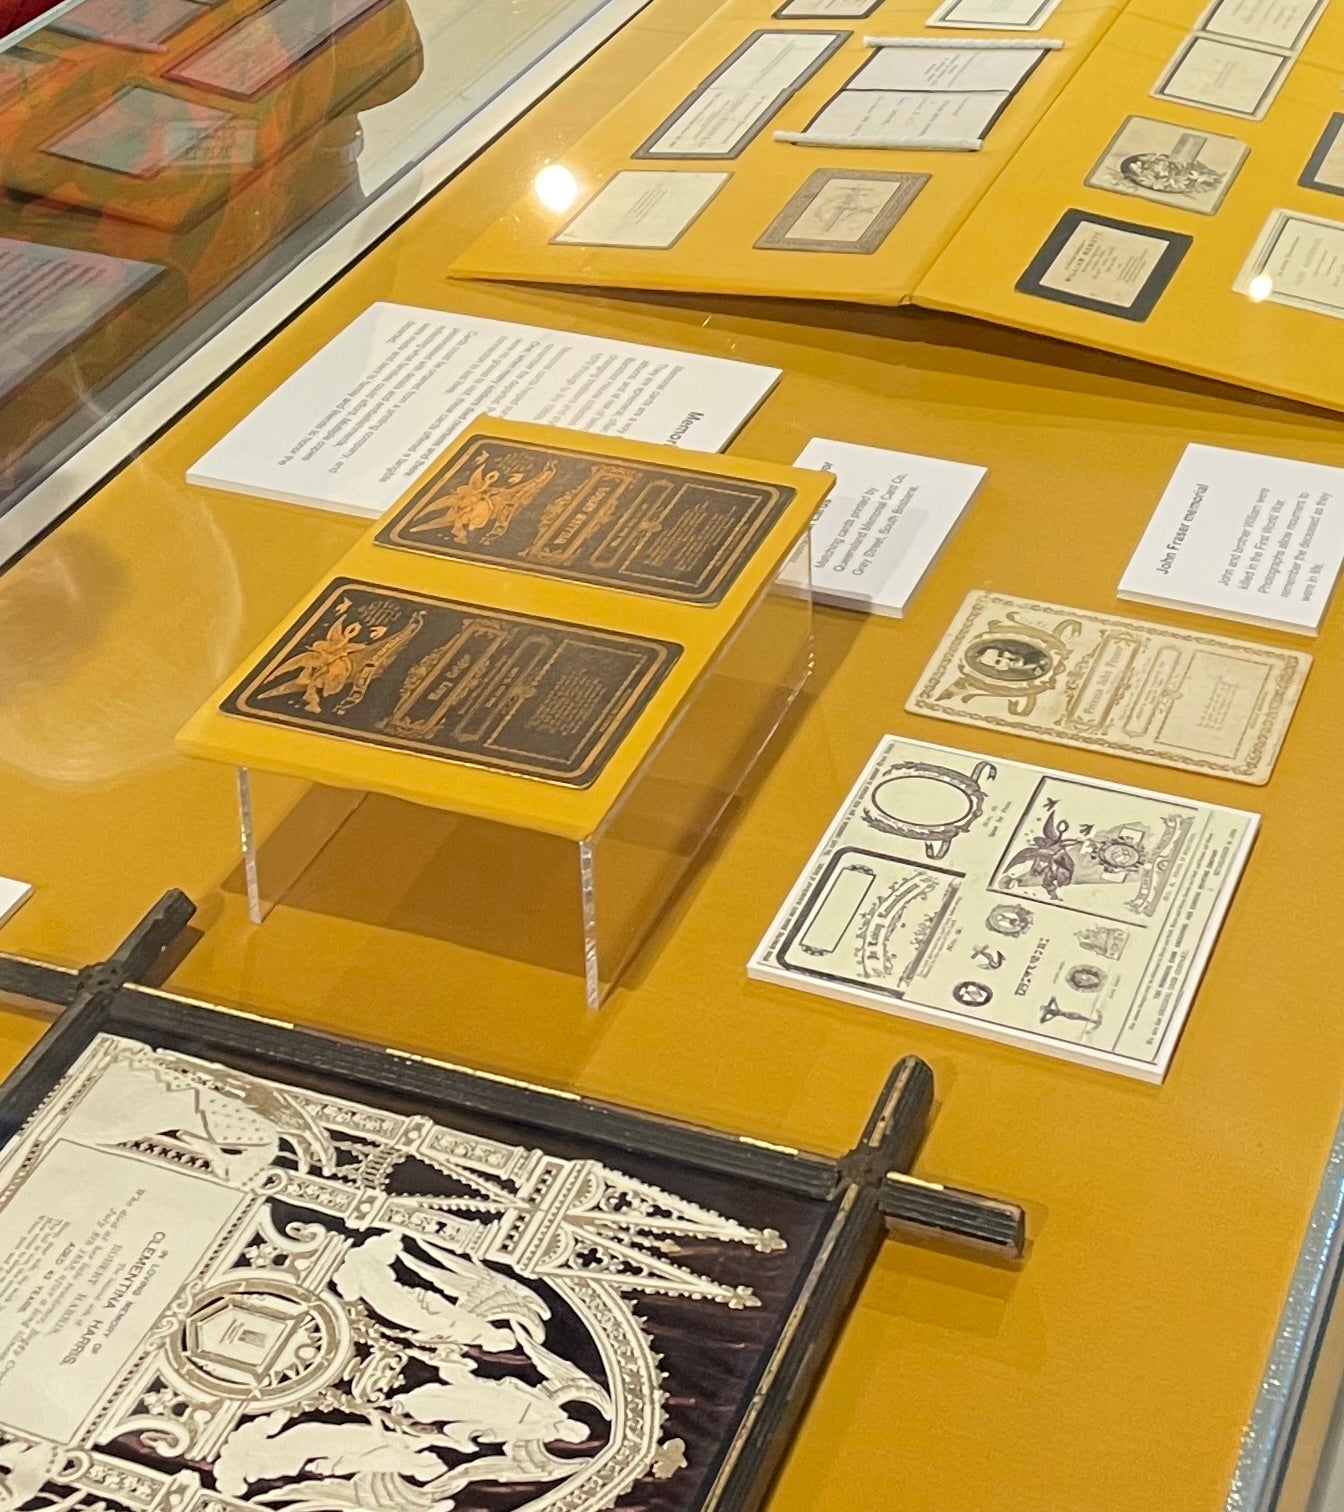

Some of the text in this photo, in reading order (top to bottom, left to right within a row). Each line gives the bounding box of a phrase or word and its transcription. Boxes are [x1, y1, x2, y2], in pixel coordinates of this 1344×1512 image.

[1153, 482, 1210, 575] John Fraser memorial
[87, 1248, 170, 1355] IN LOVING MEMORY OF
[99, 1229, 170, 1312] CLEMENTINA
